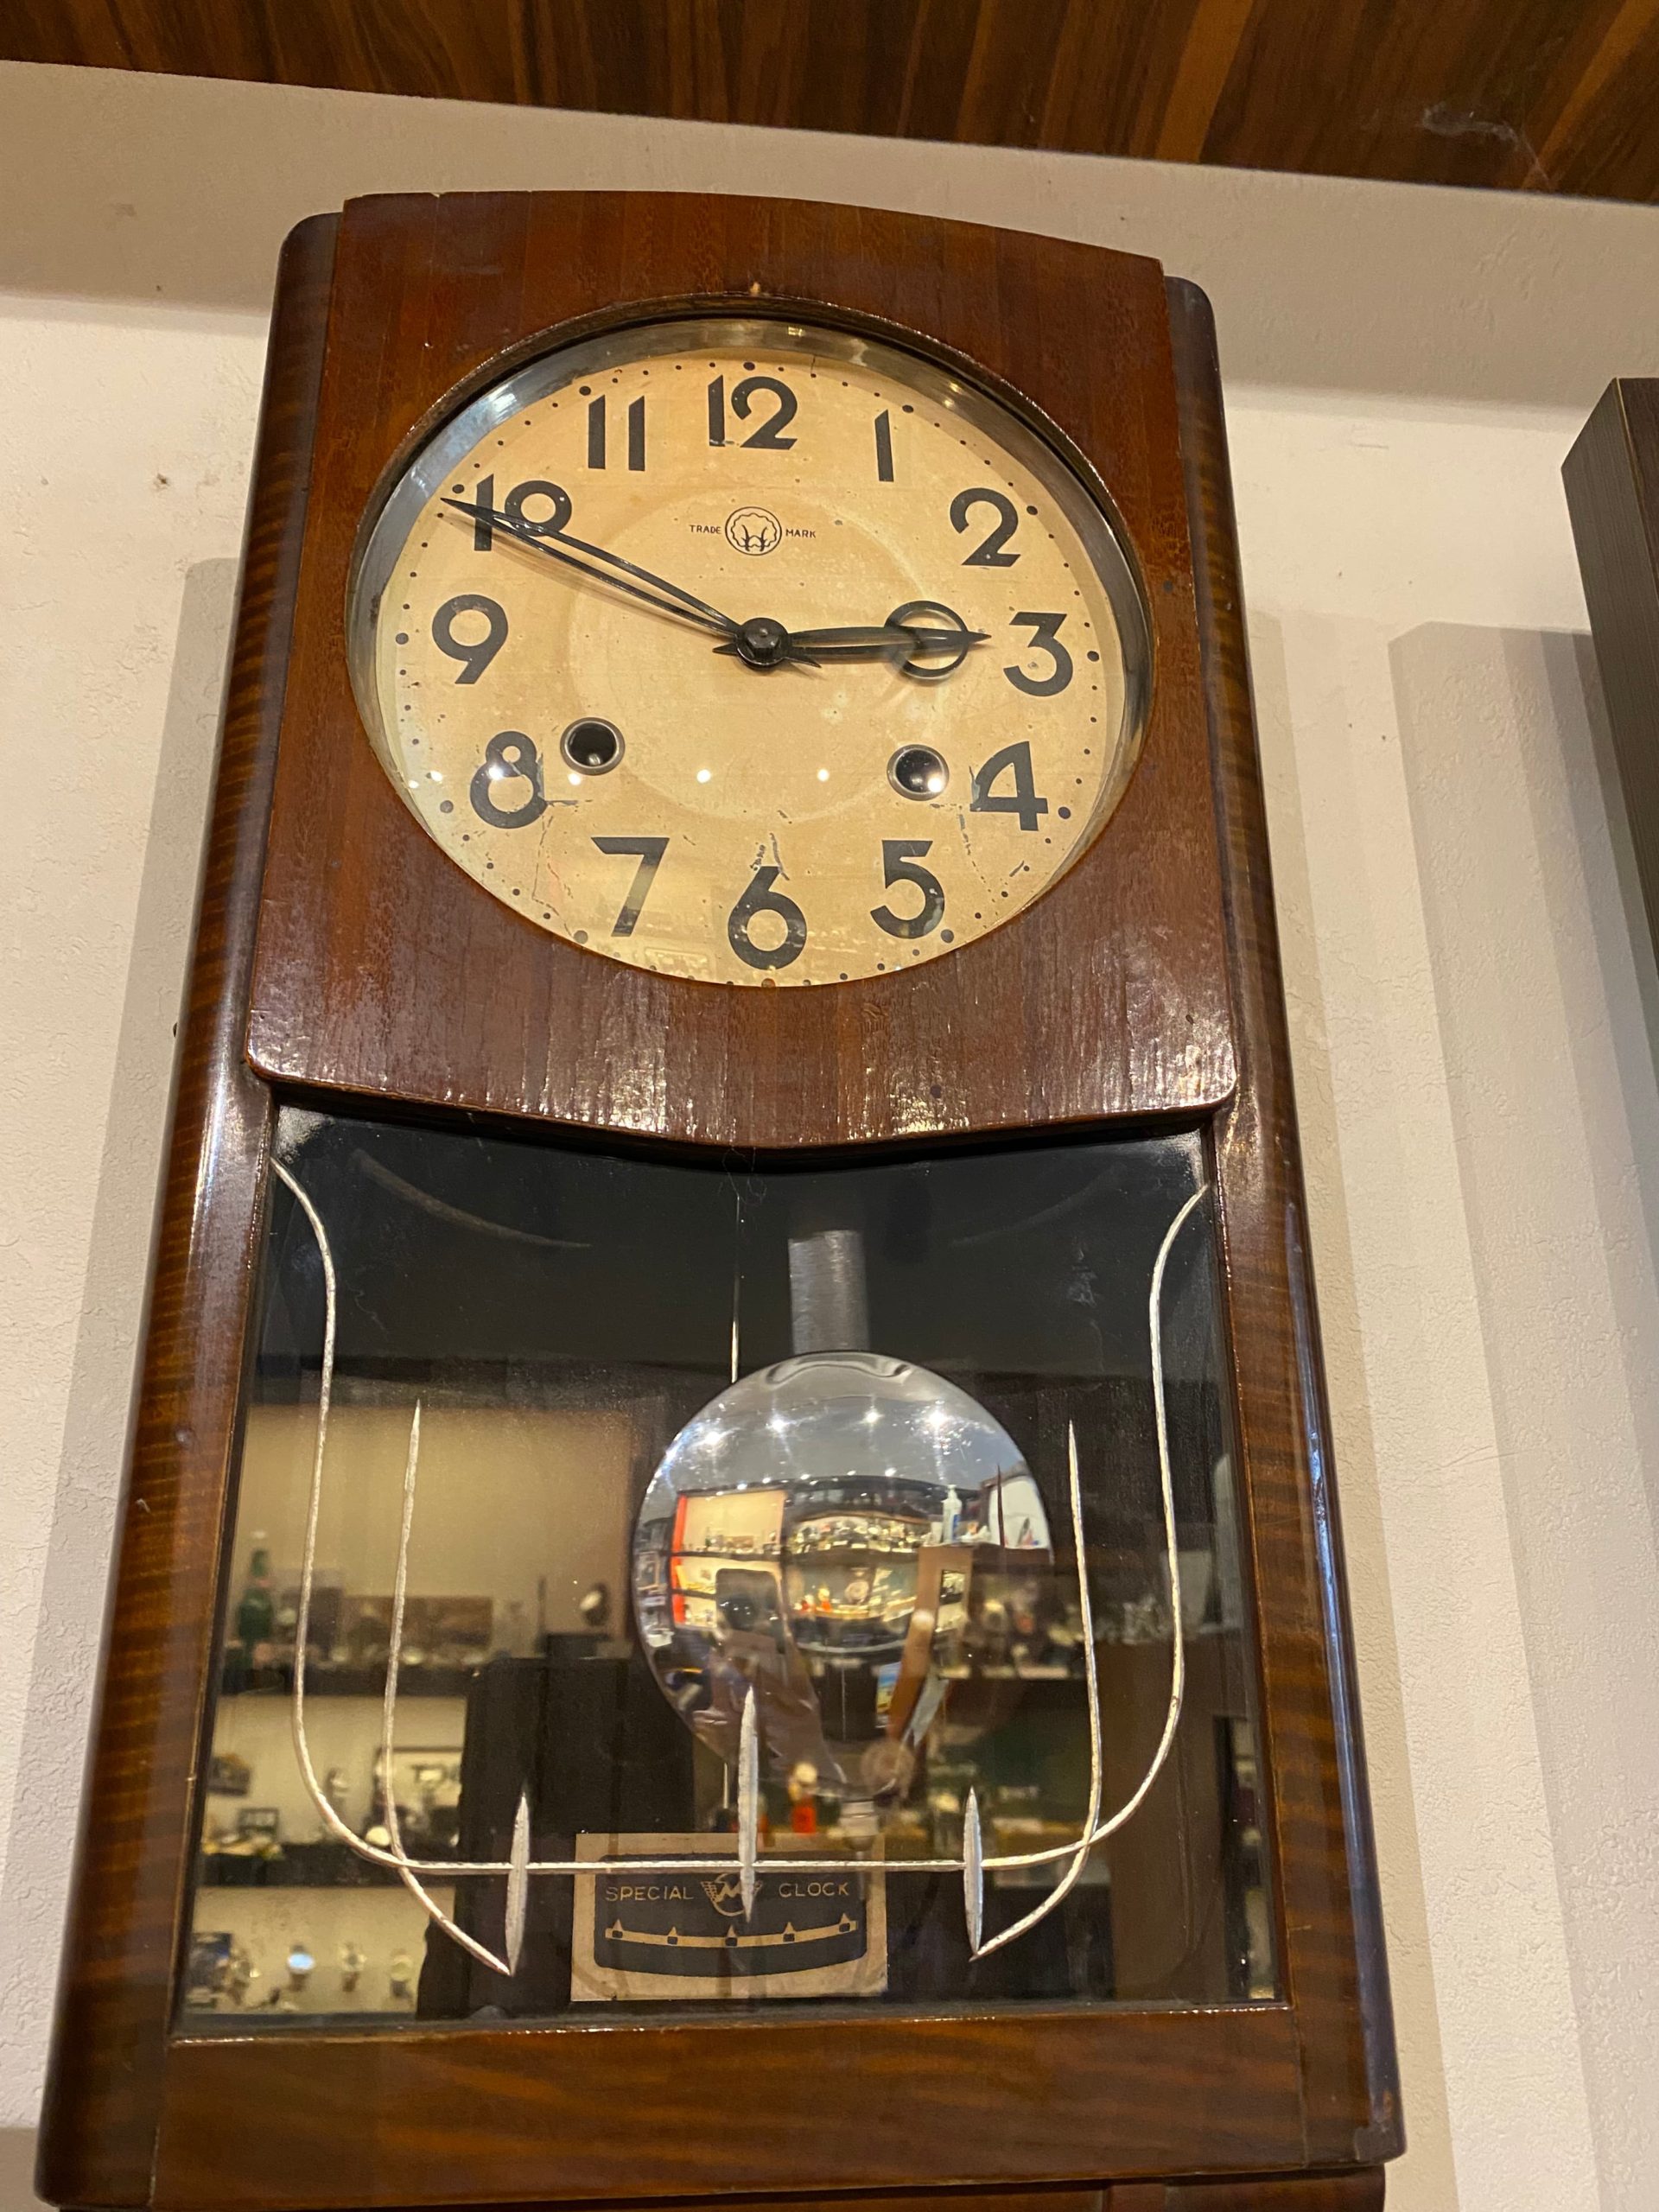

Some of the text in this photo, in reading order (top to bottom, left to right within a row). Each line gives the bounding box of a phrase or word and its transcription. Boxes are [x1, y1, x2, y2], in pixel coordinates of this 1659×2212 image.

[587, 395, 645, 472] 11
[708, 374, 798, 450] 12
[874, 410, 895, 482] 1
[474, 473, 573, 551] 10
[690, 524, 817, 539] TRADE MARK
[949, 487, 1021, 567] 2
[431, 594, 509, 684] 9
[1002, 611, 1074, 696] 3
[469, 730, 548, 830] 8
[969, 741, 1049, 831] 4
[590, 836, 671, 938] 7
[728, 866, 807, 970] 6
[870, 840, 946, 939] 5
[605, 1885, 695, 1902] SPECIAL
[779, 1881, 850, 1898] CLOCK
